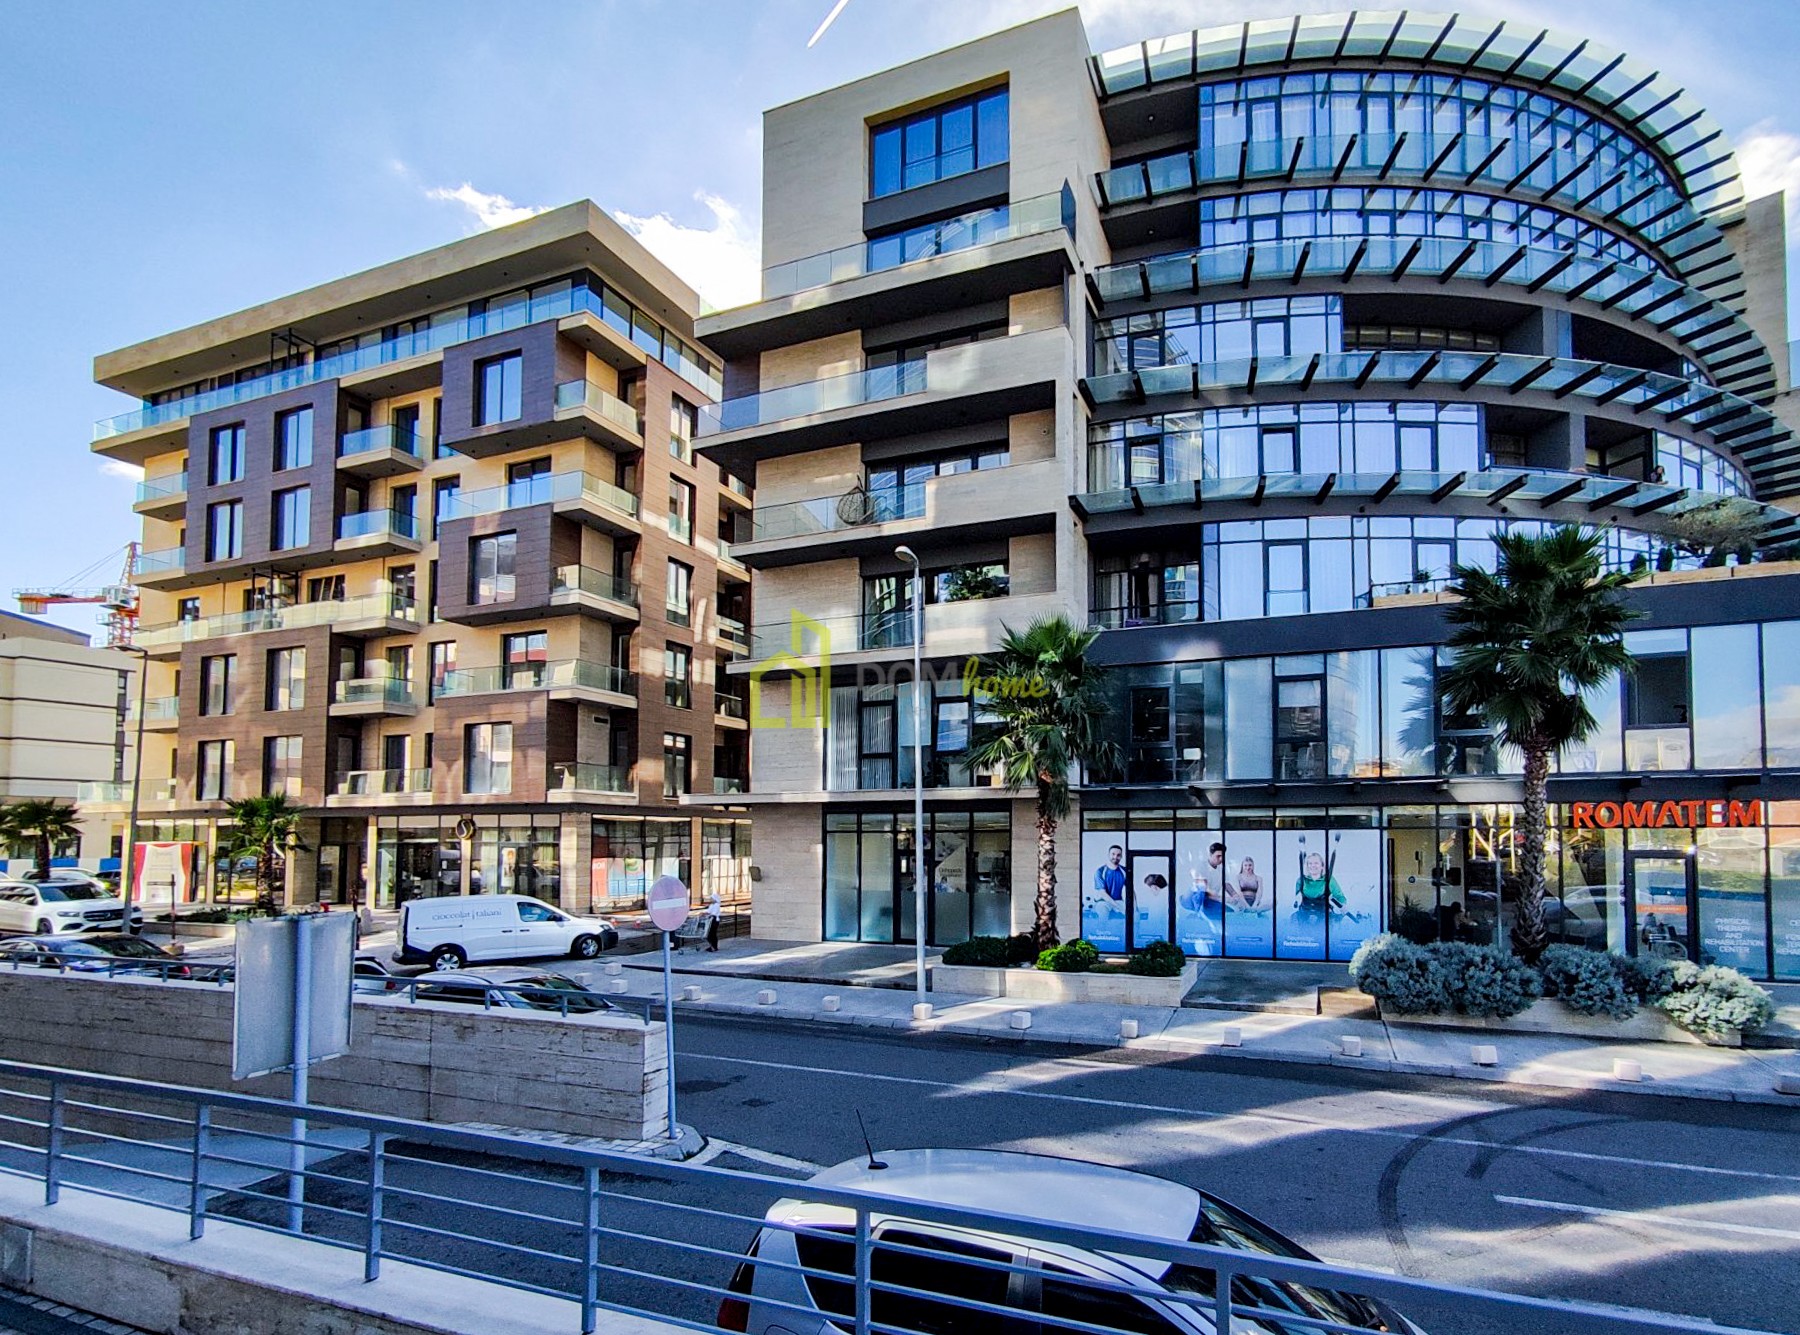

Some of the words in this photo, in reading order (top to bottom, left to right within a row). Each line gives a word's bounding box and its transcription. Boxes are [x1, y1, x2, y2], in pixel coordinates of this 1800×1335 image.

[1572, 799, 1763, 828] ROMATEM
[1704, 938, 1765, 947] REHABILITATION
[1718, 945, 1750, 953] CENTER
